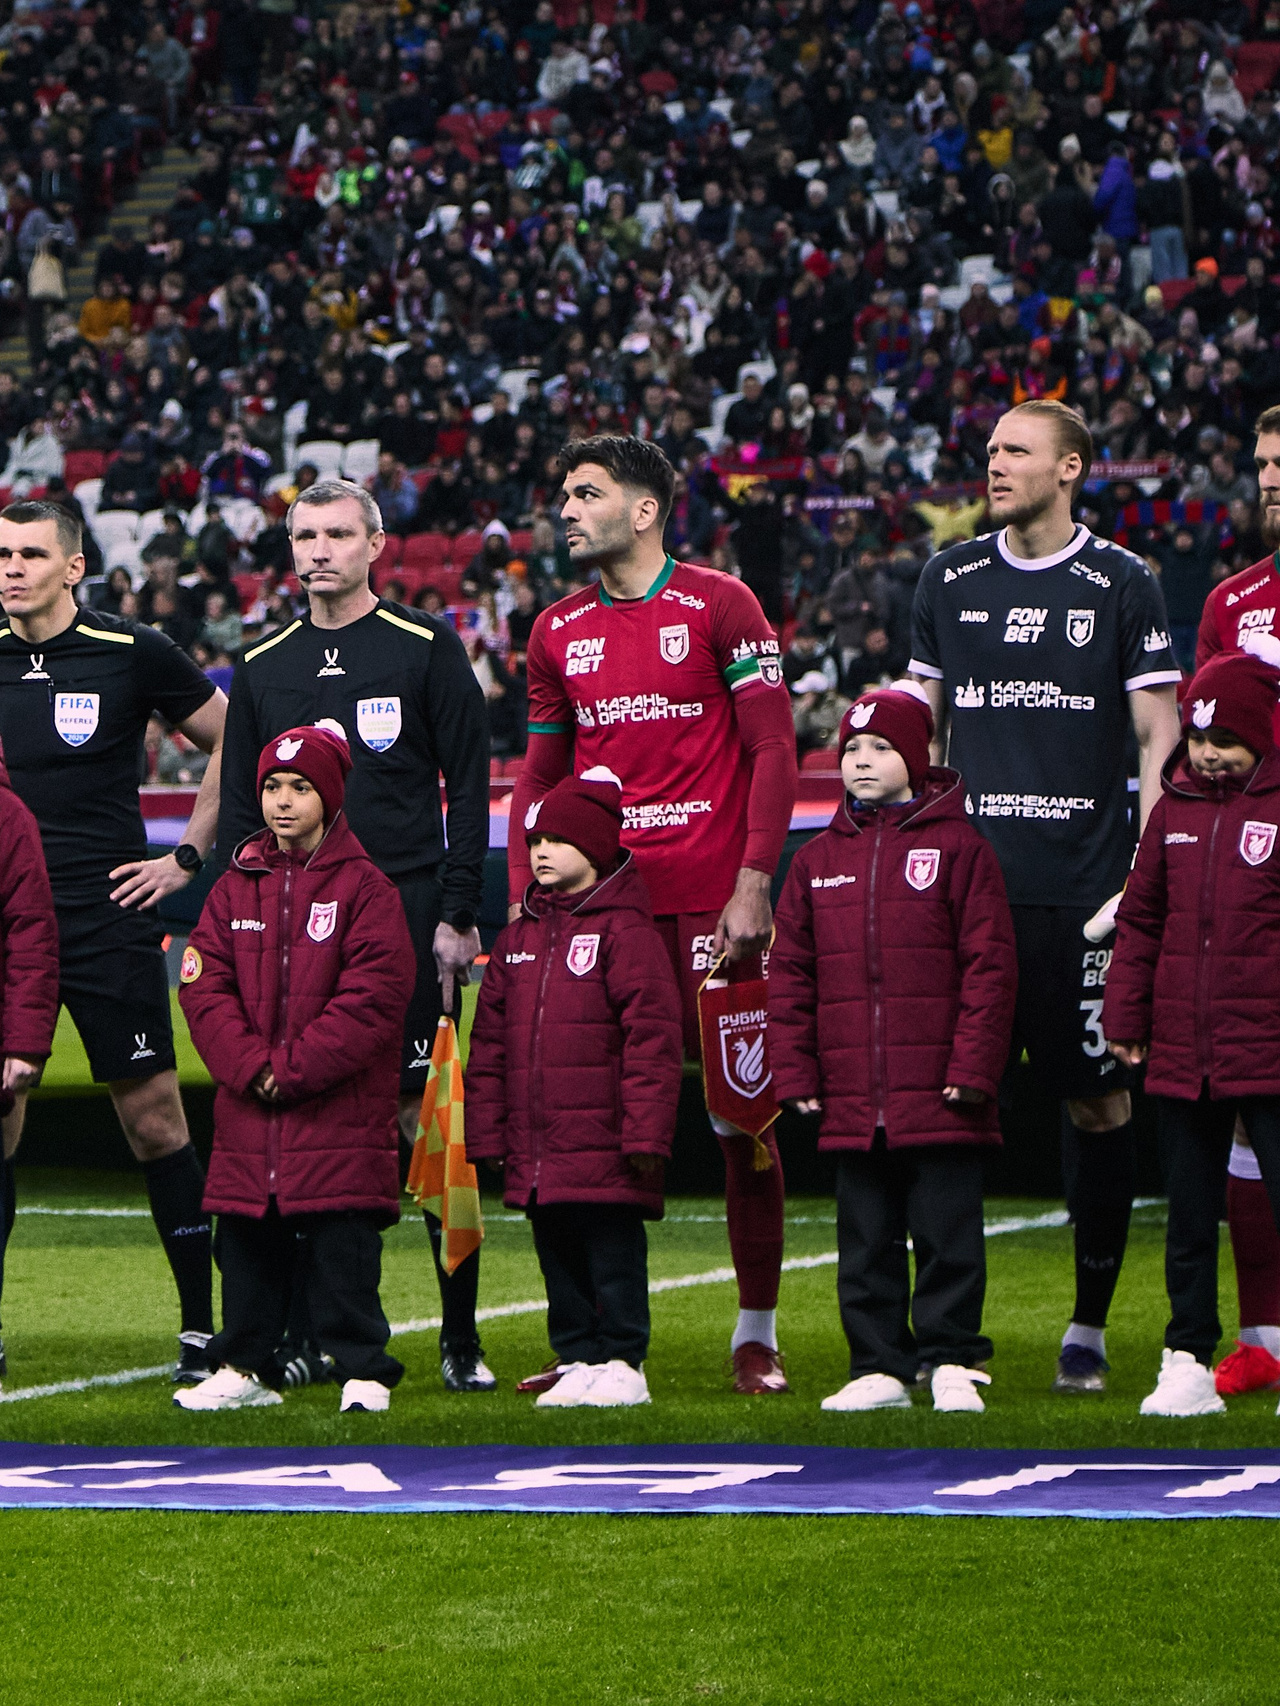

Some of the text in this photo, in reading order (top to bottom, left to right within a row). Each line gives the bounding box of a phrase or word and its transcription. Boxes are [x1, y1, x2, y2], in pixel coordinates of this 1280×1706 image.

[959, 610, 990, 623] JAKO
[1006, 607, 1049, 625] FON
[1237, 607, 1277, 630] FON
[1004, 625, 1046, 643] BET
[565, 637, 606, 658] FON
[565, 655, 605, 677] BET
[990, 681, 1062, 695] КАЗАНЬ
[60, 698, 94, 710] FIFA
[361, 702, 396, 715] FIFA
[595, 693, 669, 713] КАЗАНЬ
[990, 694, 1095, 710] ОРГСИНТЕЗ
[598, 702, 704, 726] ОРГСИНТЕЗ
[980, 793, 1095, 810] НИЖНЕКАМСК
[978, 805, 1071, 821] НЕФТЕХИМ
